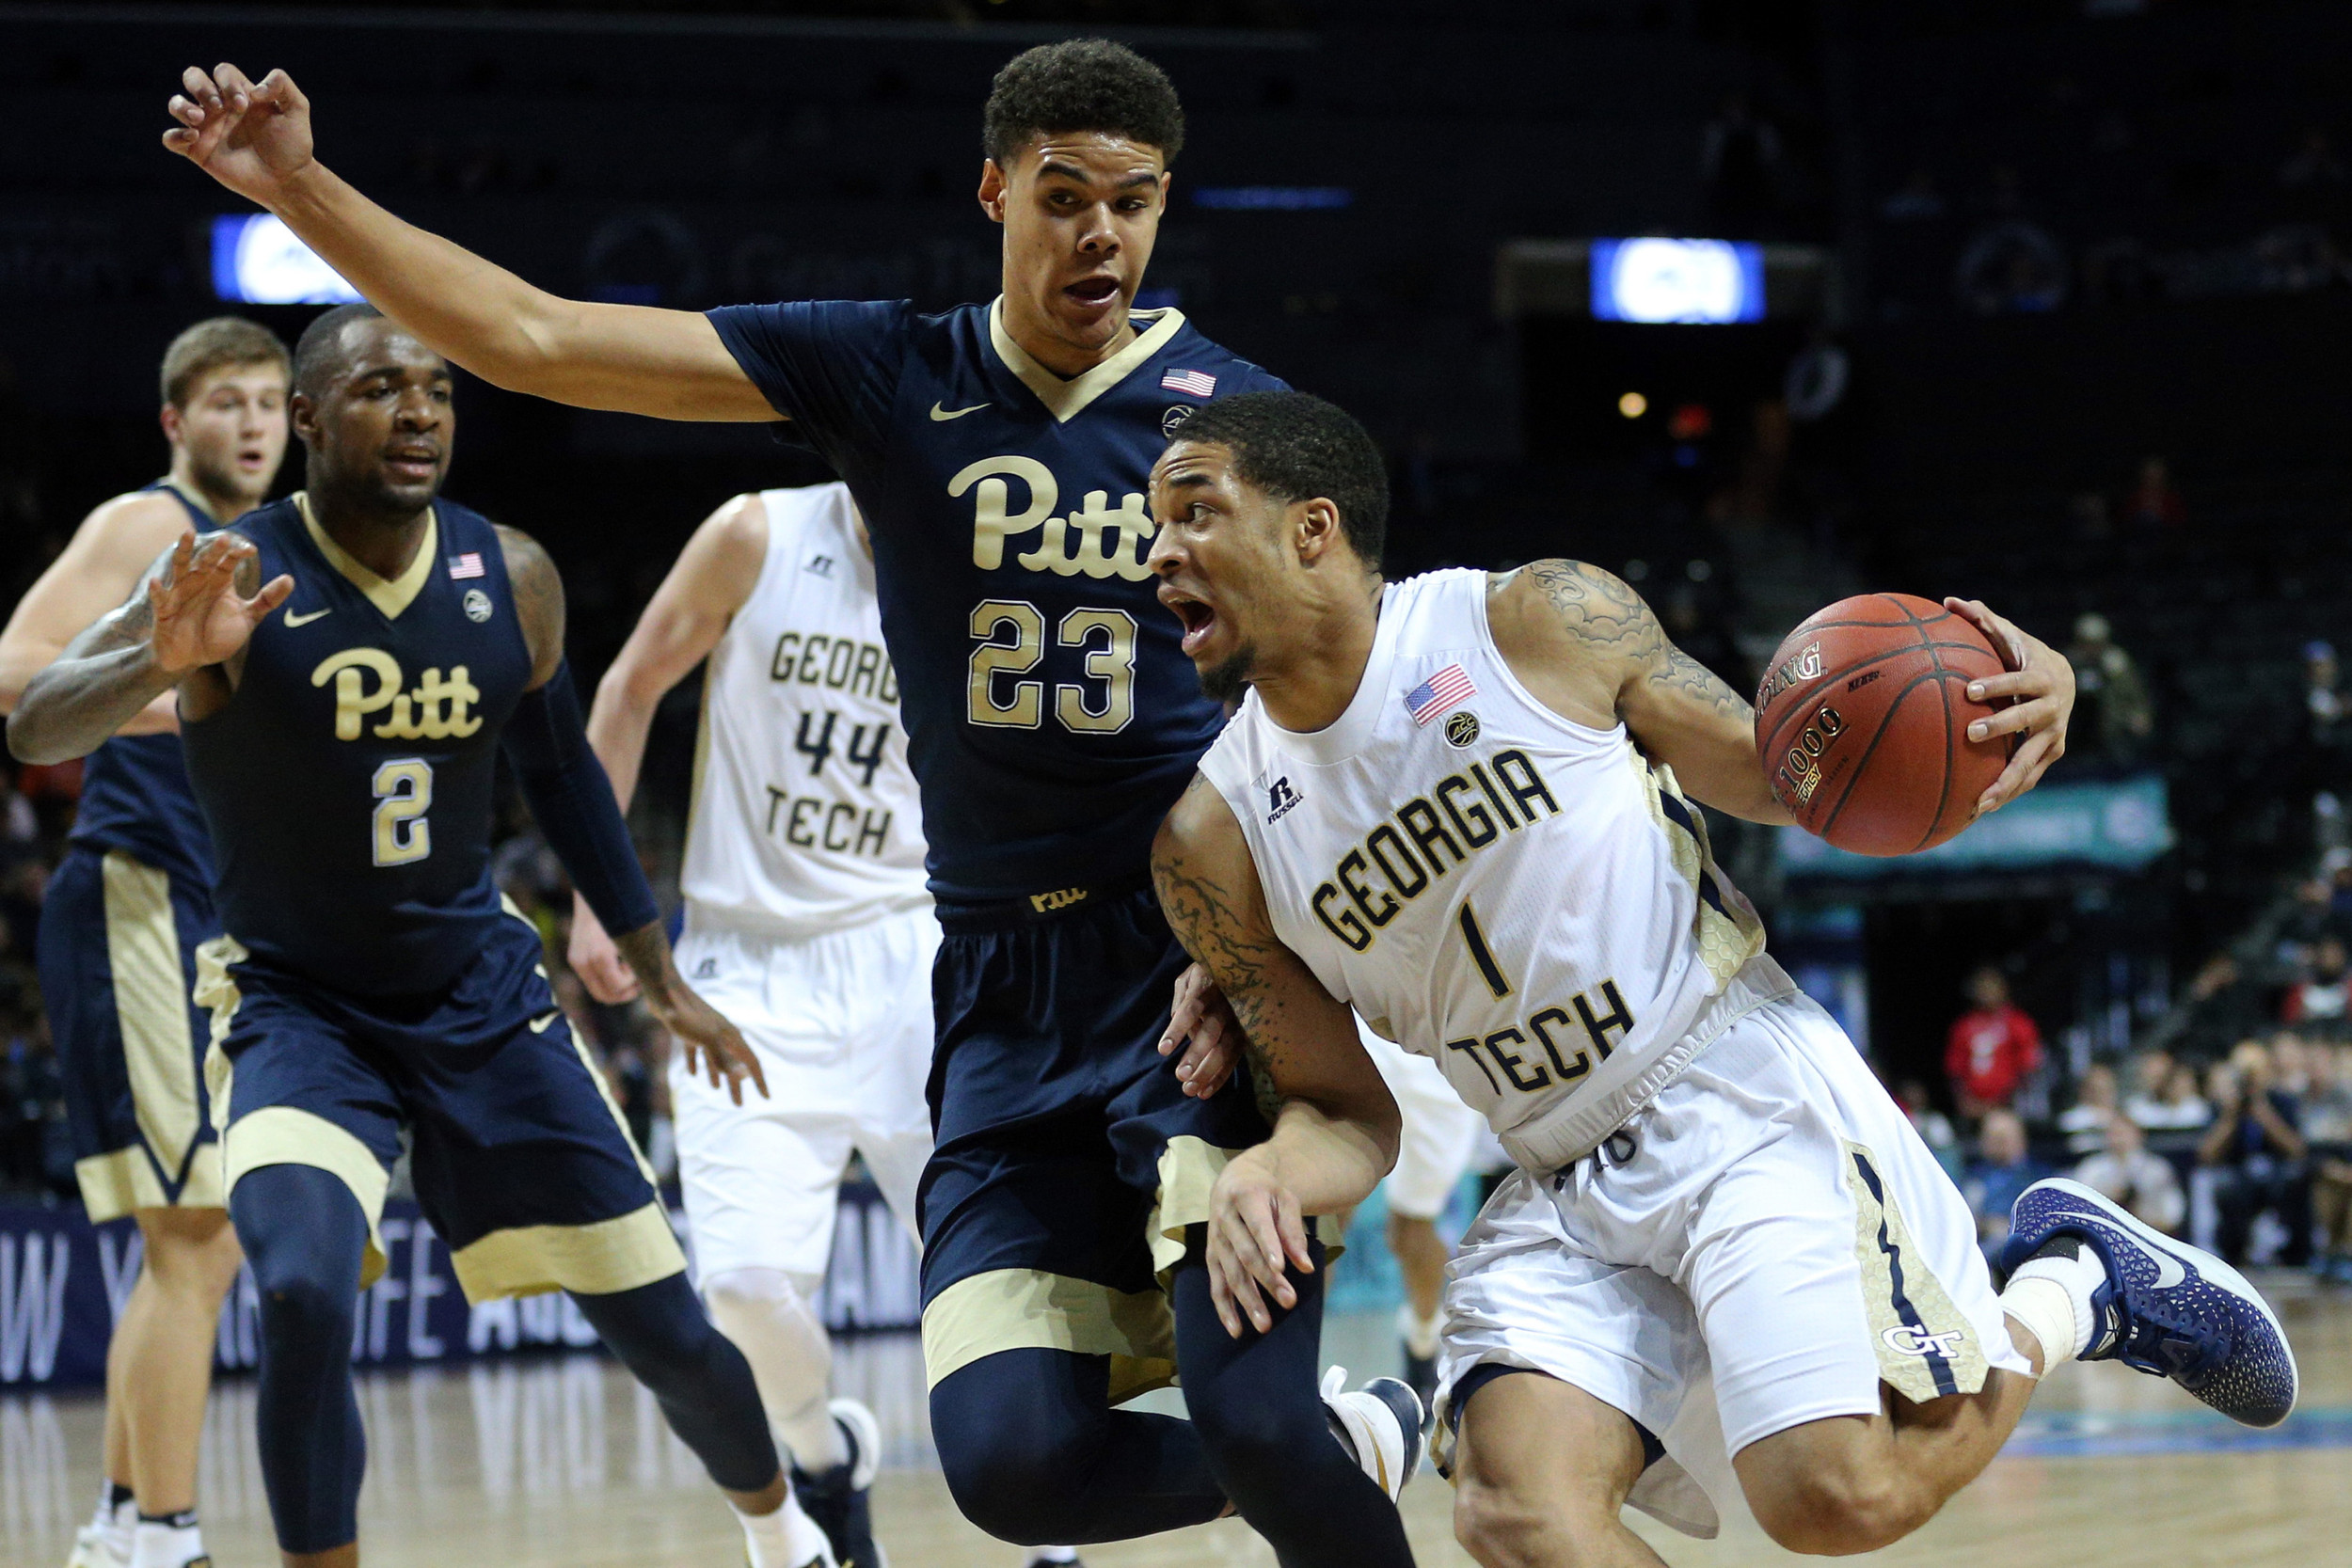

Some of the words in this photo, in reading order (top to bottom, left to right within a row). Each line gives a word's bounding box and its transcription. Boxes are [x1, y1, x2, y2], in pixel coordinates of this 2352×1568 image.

[947, 455, 1155, 581] Pitt
[311, 647, 484, 741] Pitt
[967, 599, 1138, 735] 23
[795, 710, 892, 787] 44
[372, 757, 433, 867] 2
[766, 784, 893, 857] TECH
[1267, 791, 1304, 825] RUSSELL
[1310, 749, 1563, 953] GEORGIA
[1458, 894, 1516, 1003] 1
[1446, 976, 1635, 1097] TECH
